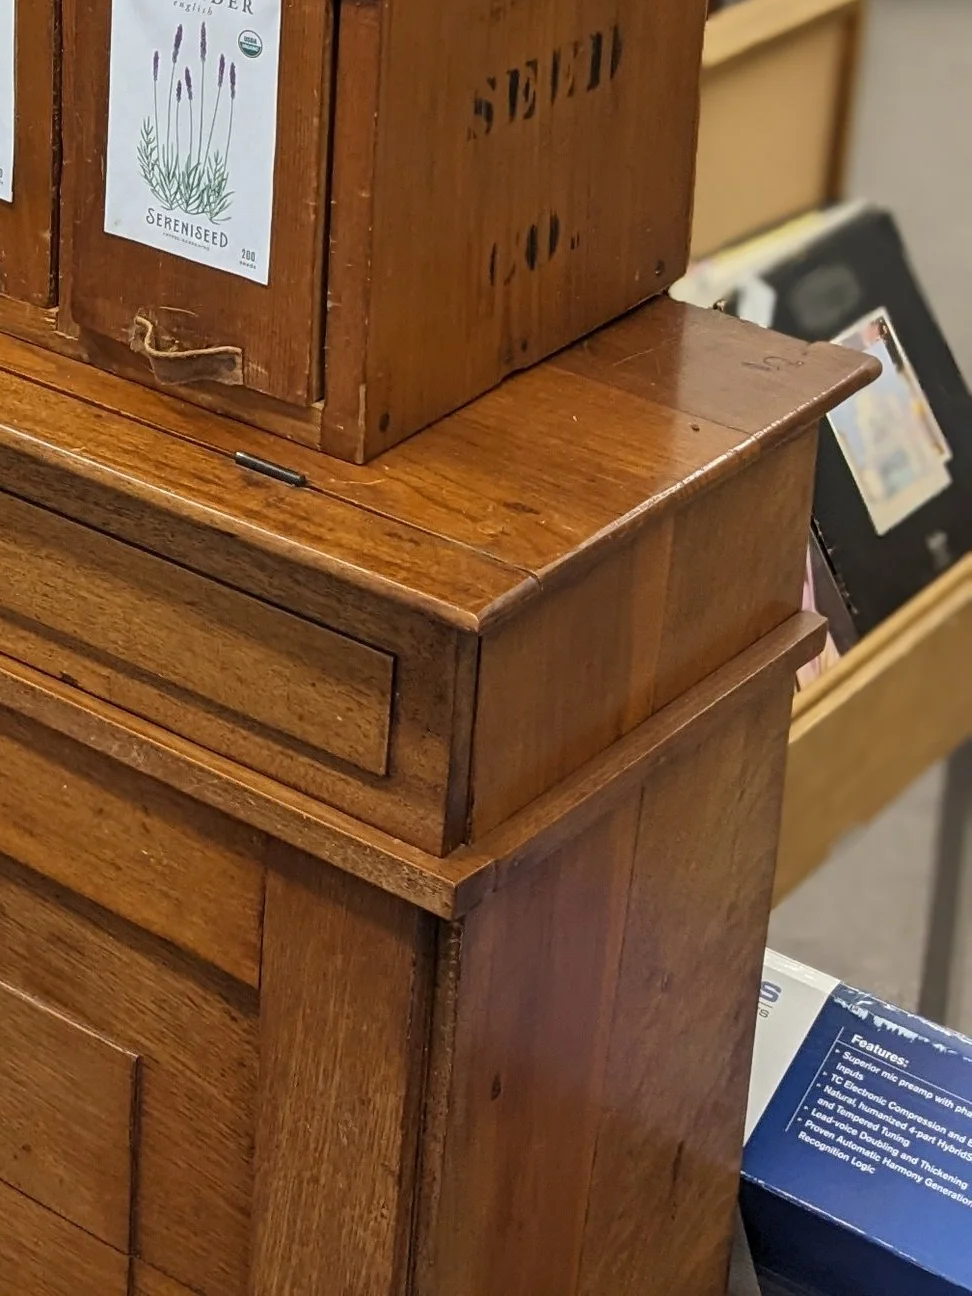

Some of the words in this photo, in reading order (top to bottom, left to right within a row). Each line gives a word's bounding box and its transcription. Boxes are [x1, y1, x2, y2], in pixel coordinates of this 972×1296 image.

[173, 0, 213, 16] english
[145, 207, 228, 248] SERENISEED
[851, 1033, 910, 1068] Features:
[842, 1051, 881, 1074] Superior
[881, 1070, 898, 1083] mic
[898, 1079, 933, 1099] preamp
[935, 1095, 955, 1109] with
[817, 1098, 836, 1110] and
[836, 1105, 880, 1131] Tempered
[881, 1126, 911, 1147] Tuning
[823, 1085, 857, 1107] Natural,
[858, 1101, 908, 1130] humanized
[908, 1126, 937, 1144] 4-part
[830, 1073, 844, 1085] TC
[843, 1080, 887, 1106] Electronic
[888, 1101, 947, 1134] Compression
[948, 1130, 967, 1143] and
[798, 1131, 850, 1162] Recognition
[850, 1156, 876, 1174] Logic
[805, 1119, 836, 1140] Proven
[836, 1135, 881, 1162] Automatic
[882, 1156, 924, 1183] Harmony
[811, 1107, 858, 1135] Lead-voice
[859, 1131, 899, 1157] Doubling
[900, 1152, 919, 1165] and
[920, 1159, 968, 1190] Thickening
